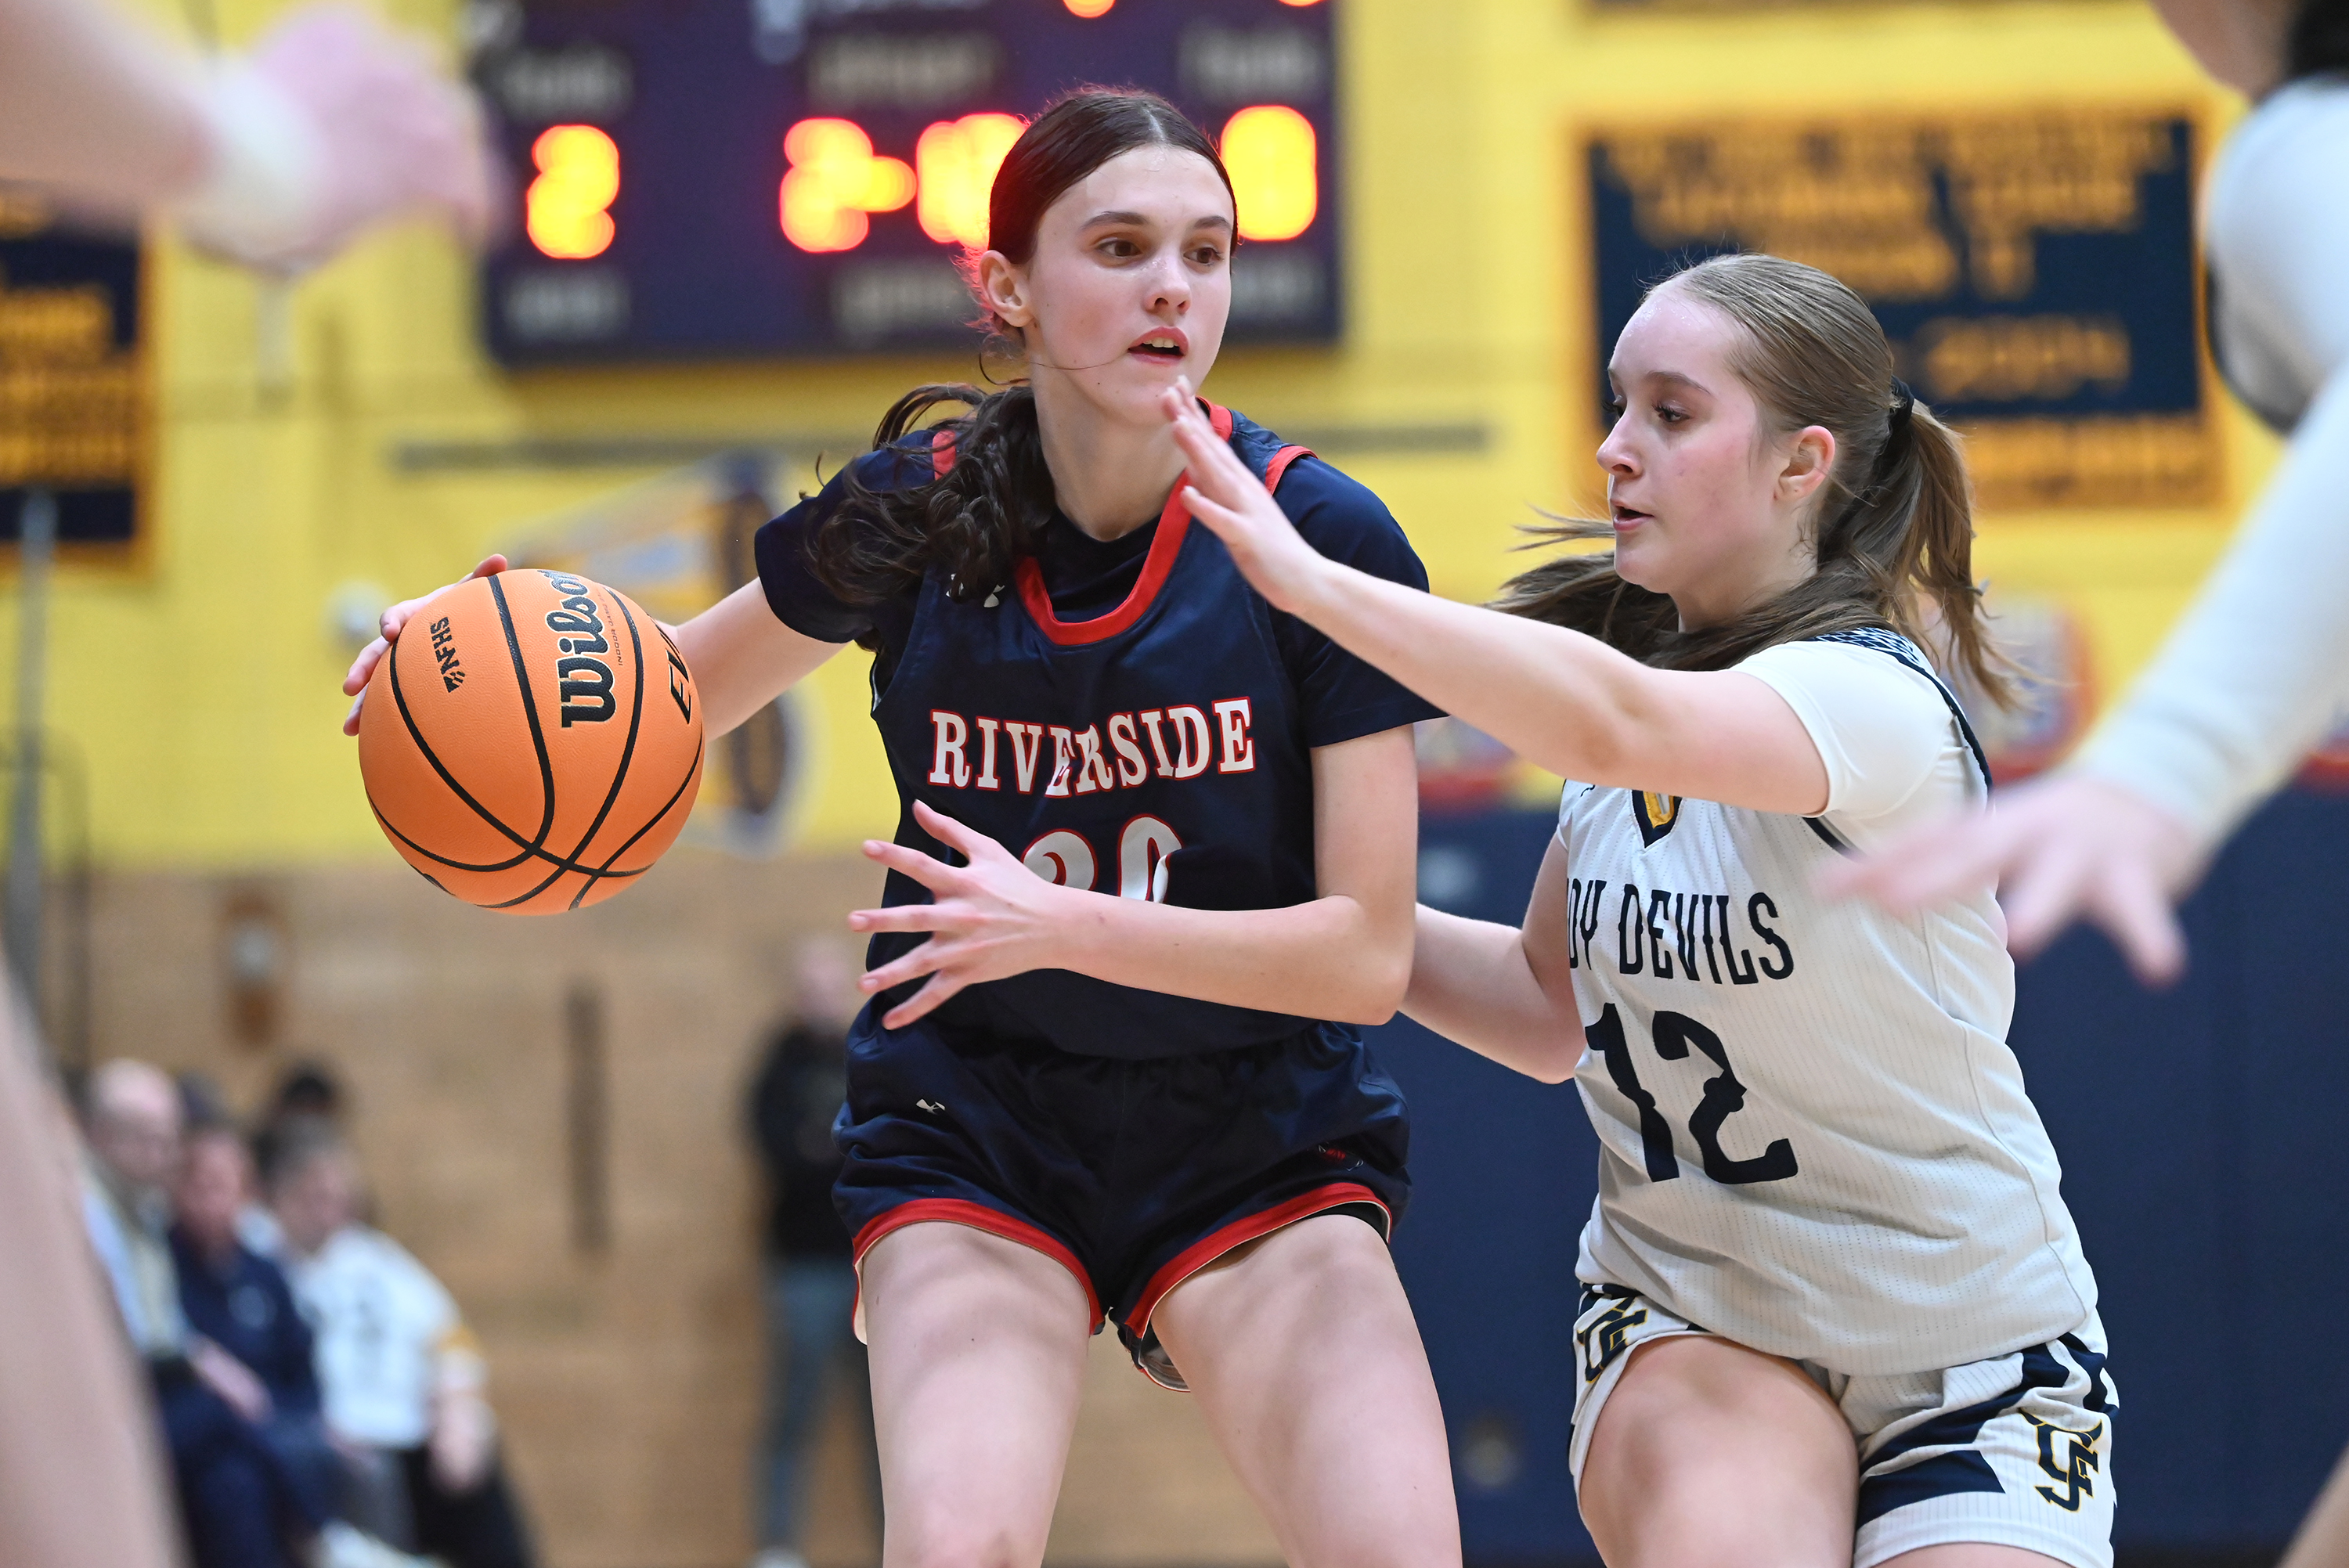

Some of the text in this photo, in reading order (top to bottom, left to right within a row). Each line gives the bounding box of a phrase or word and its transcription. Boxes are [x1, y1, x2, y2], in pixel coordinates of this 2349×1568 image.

[430, 617, 460, 675] NFHS
[537, 569, 617, 728] Wilson
[611, 629, 624, 666] INDOOR
[927, 696, 1256, 798] RIVERSIDE
[1567, 878, 1795, 986] DY DEVILS
[1584, 1002, 1799, 1185] 12
